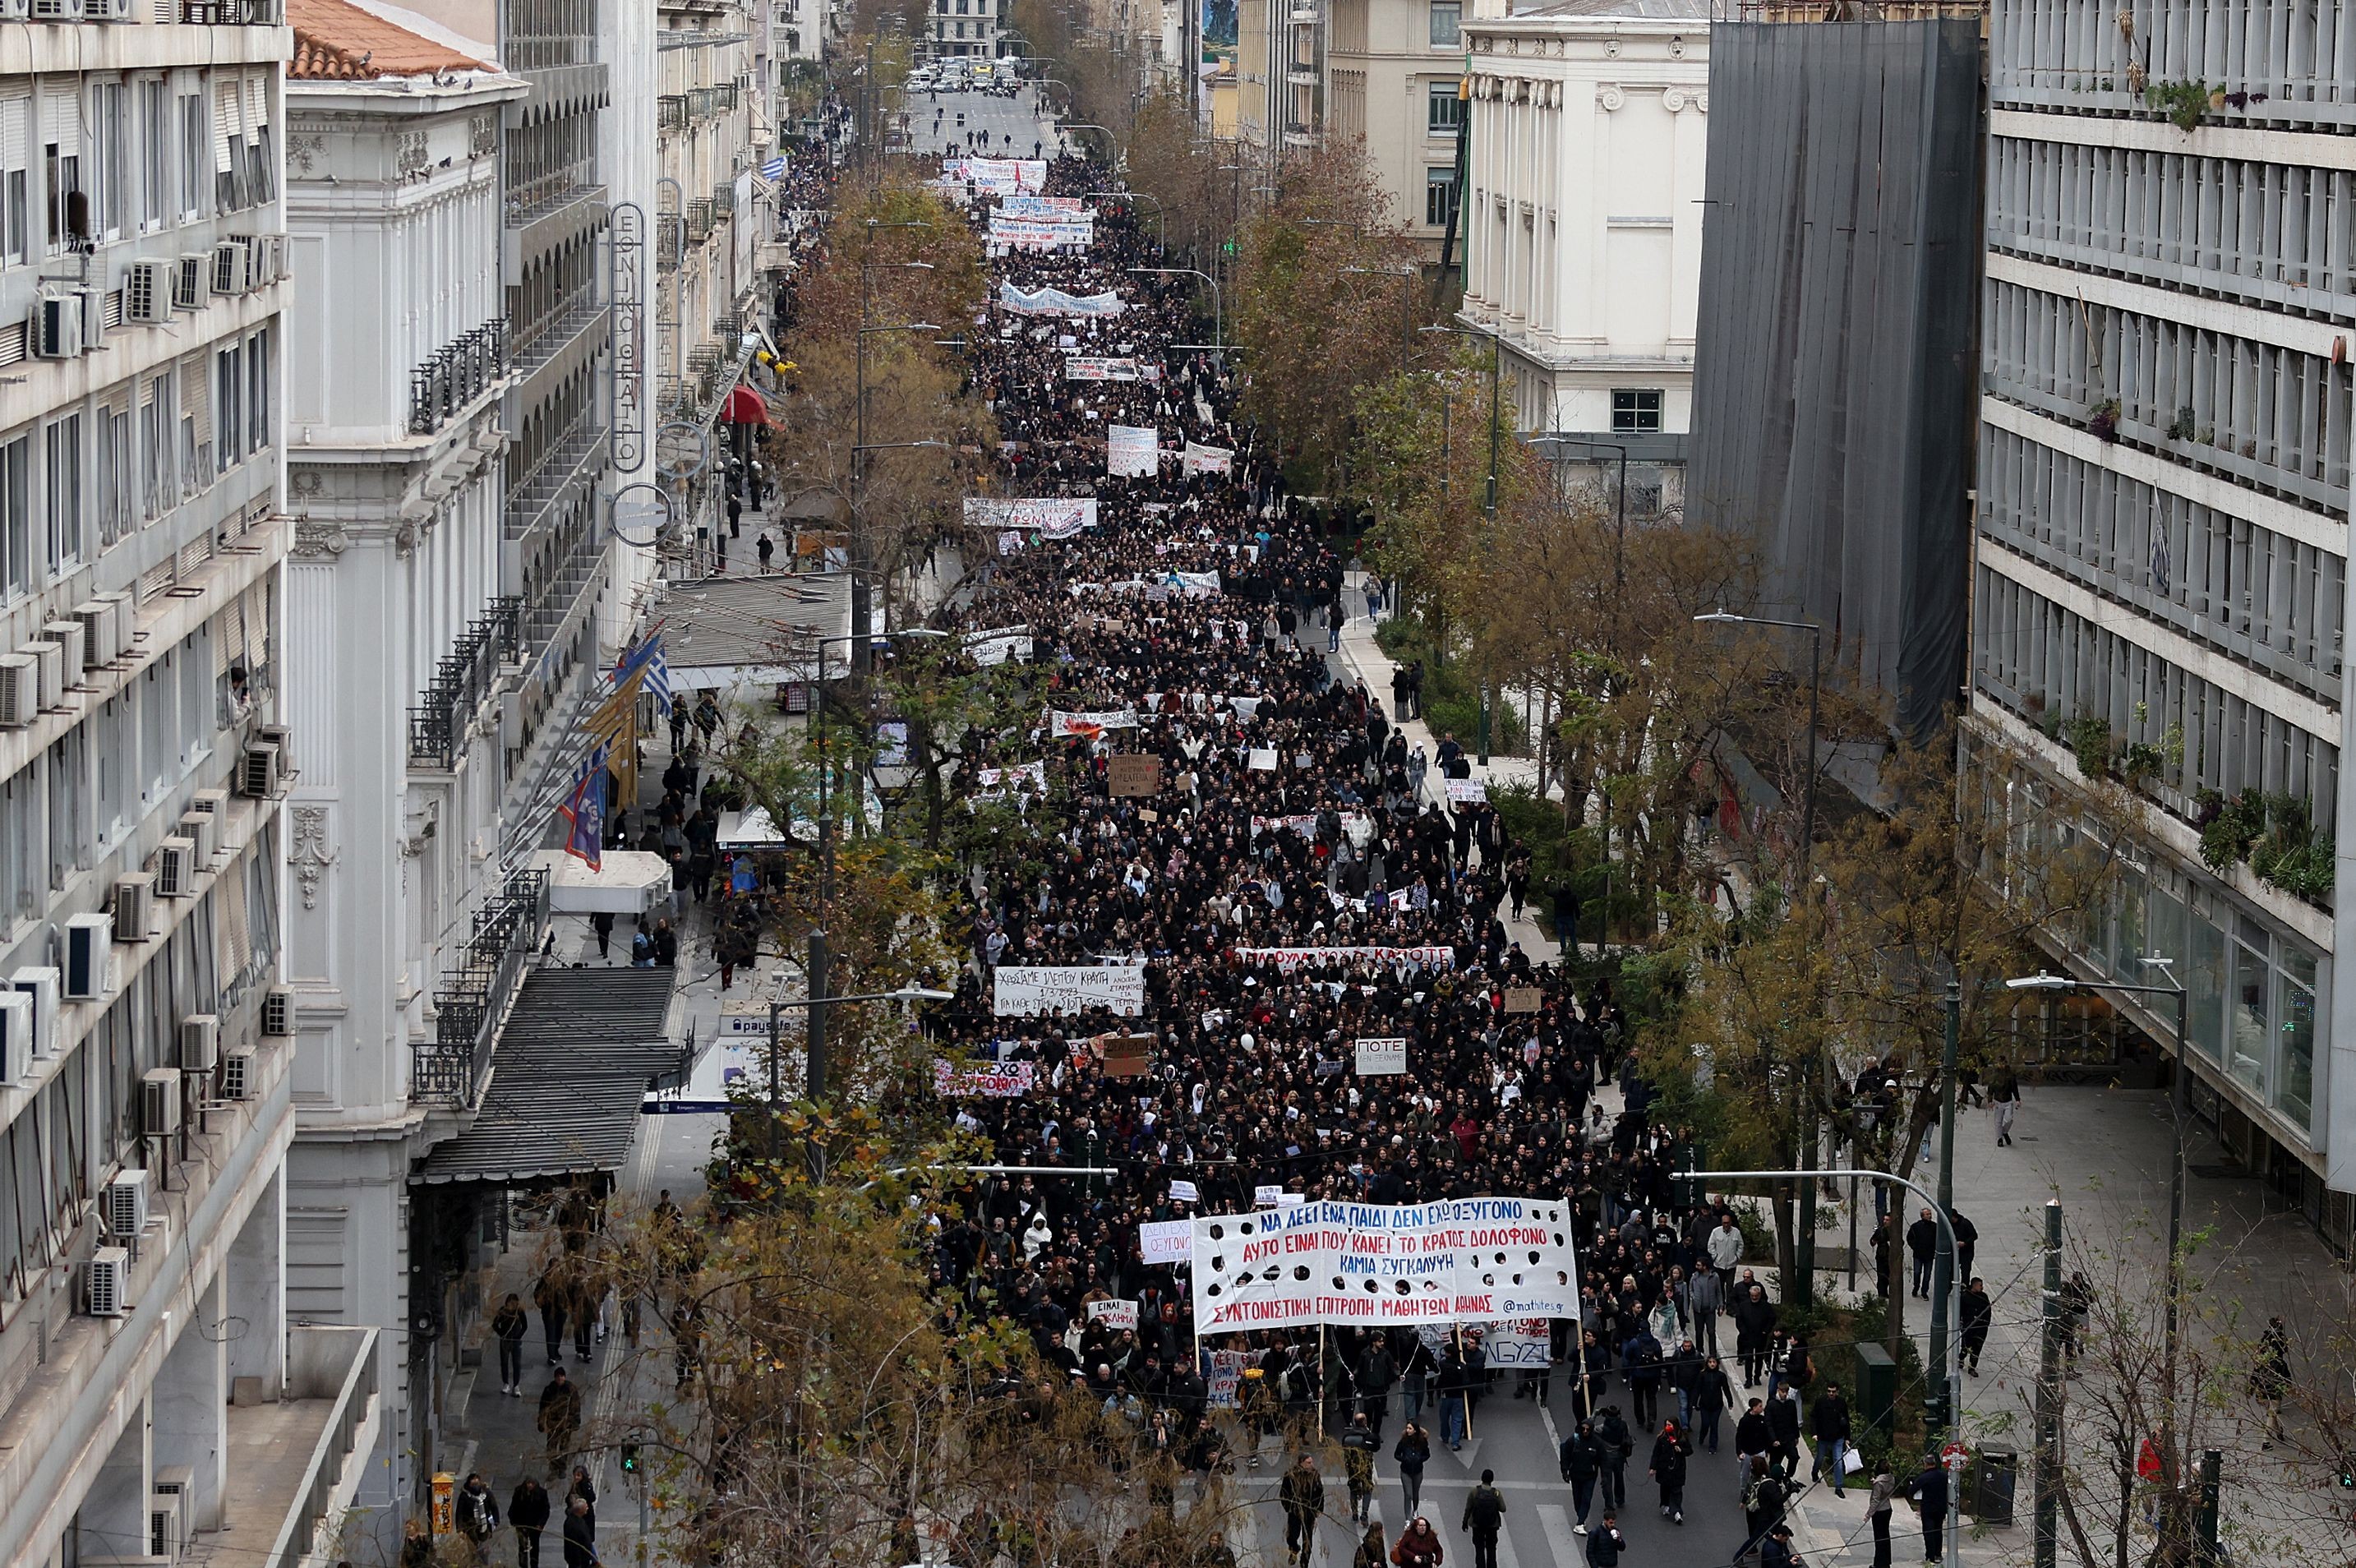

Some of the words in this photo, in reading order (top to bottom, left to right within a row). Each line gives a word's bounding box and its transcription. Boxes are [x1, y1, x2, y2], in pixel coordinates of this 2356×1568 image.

[1081, 971, 1109, 987] ΚΡΑΥΓΗ
[1000, 998, 1010, 1010] ΓΙΑ
[1012, 998, 1030, 1011] ΚΑΘΕ
[1358, 1040, 1404, 1053] ΠΟΤΕ
[1261, 1213, 1281, 1233] ΝΑ
[1286, 1205, 1318, 1229] ΛΕΕΙ
[1322, 1201, 1346, 1224] ΕΝΑ
[1349, 1206, 1387, 1228] ΠΑΙΔΙ
[1392, 1208, 1422, 1228] ΔΕΝ
[1428, 1202, 1450, 1225] ΕΧΩ
[1453, 1201, 1523, 1221] ΟΞΥΓΟΝΟ
[1145, 1224, 1167, 1237] ΔΕΝ
[1243, 1238, 1279, 1262] ΑΥΤΟ
[1284, 1232, 1318, 1253] ΕΙΝΑΙ
[1322, 1230, 1348, 1249] ΠΟΥ
[1352, 1234, 1390, 1254] ΚΑΝΕΙ
[1399, 1236, 1416, 1254] ΤΟ
[1422, 1229, 1466, 1253] ΚΡΑΤΟΣ
[1470, 1227, 1547, 1247] ΔΟΛΟΦΟΝΟ
[1339, 1255, 1376, 1274] ΚΑΜΙΑ
[1381, 1253, 1454, 1275] ΣΥΓΚΑΛΥΨΗ
[1098, 1301, 1119, 1312] ΕΙΝΑΙ
[1213, 1298, 1311, 1323] ΣΥΝΤΟΝΙΣΤΙΚΗ
[1316, 1296, 1374, 1317] ΕΠΙΤΡΟΠΗ
[1381, 1297, 1449, 1317] ΜΑΘΗΤΩΝ
[1455, 1294, 1494, 1313] ΑΘΗΝΑΣ
[1503, 1299, 1565, 1313] @mathites.gr
